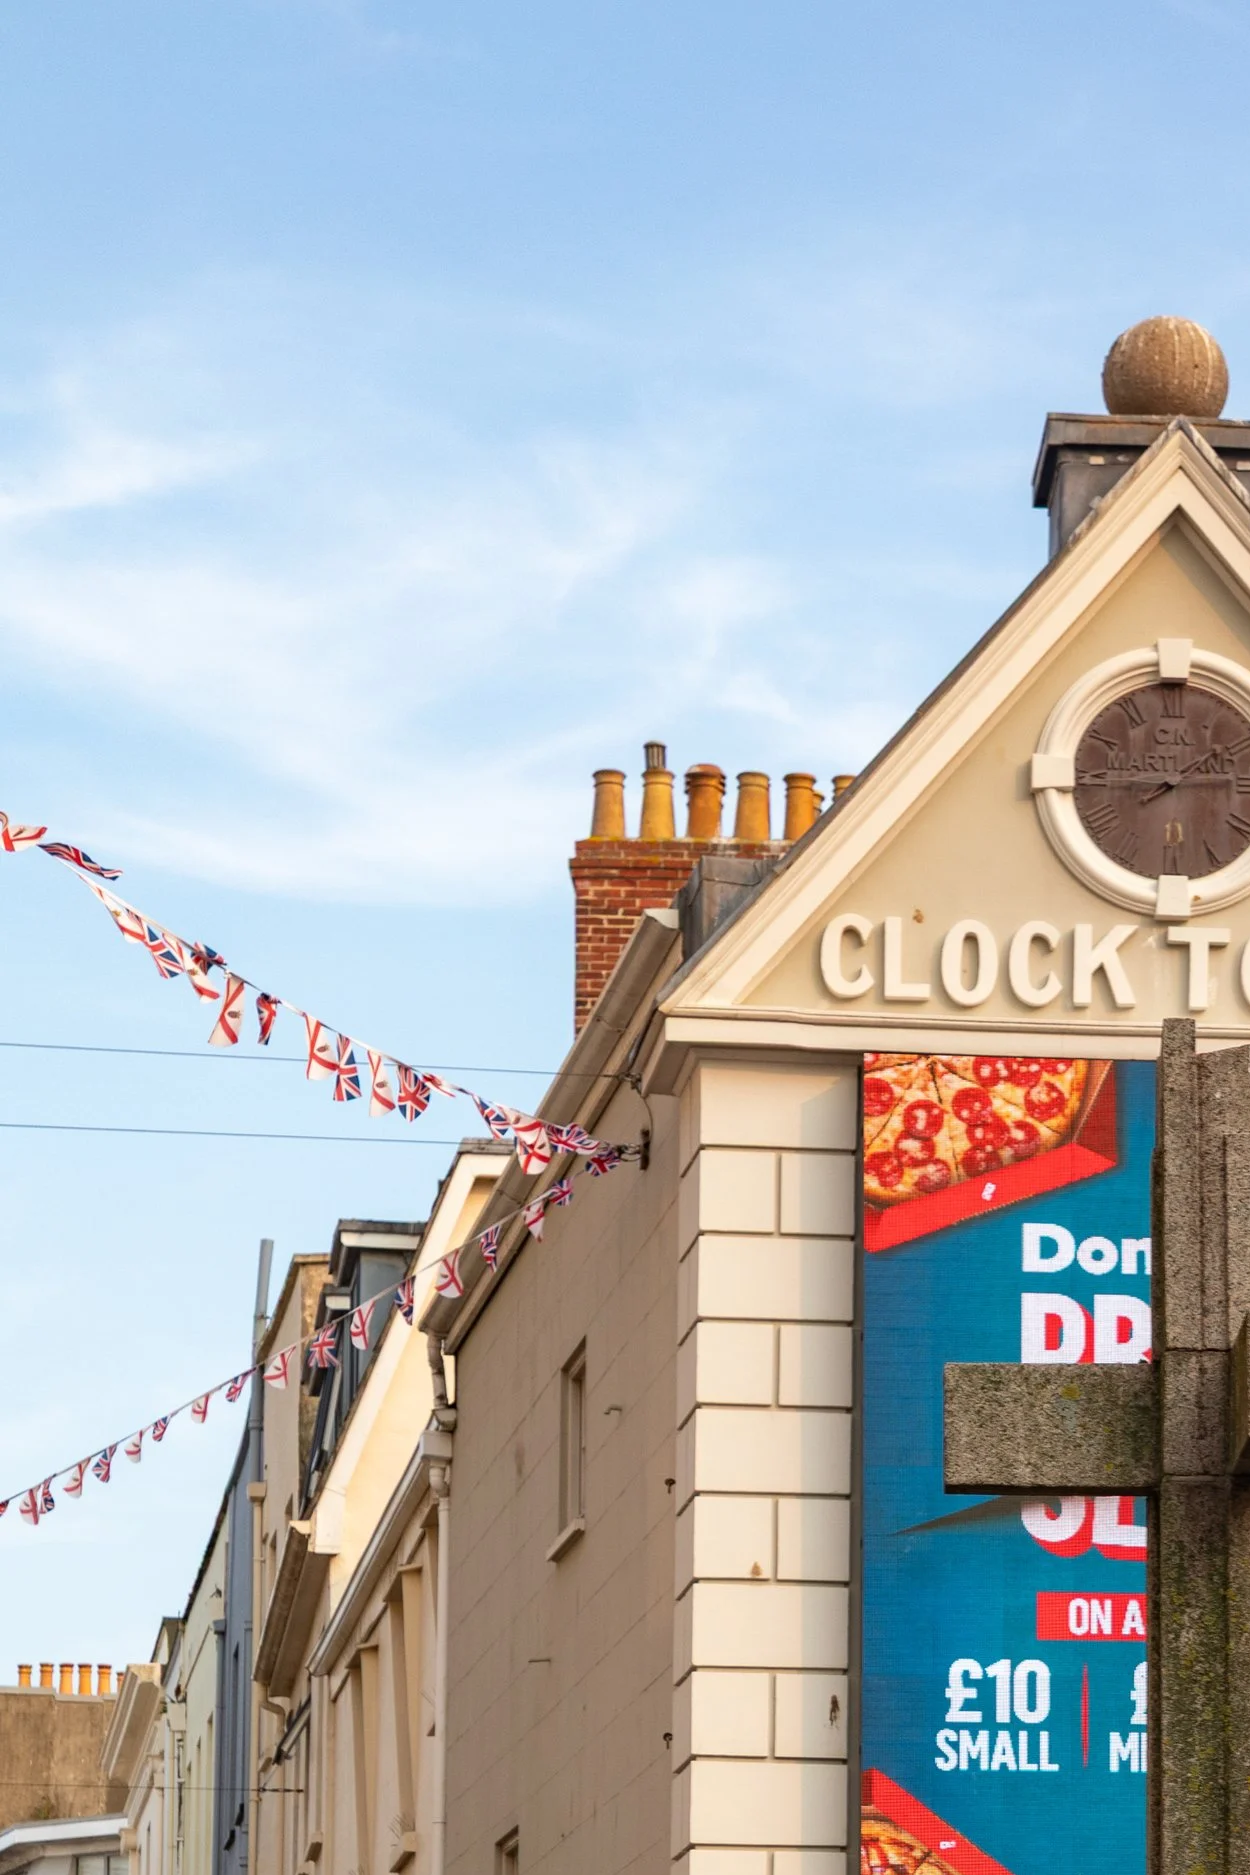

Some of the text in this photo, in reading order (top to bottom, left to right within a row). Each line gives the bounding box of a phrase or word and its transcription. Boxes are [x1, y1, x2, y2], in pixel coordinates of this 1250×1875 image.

[819, 911, 1139, 1010] CLOCK
[1068, 1597, 1113, 1636] ON
[944, 1658, 1052, 1725] £10
[934, 1729, 1059, 1773] SMALL
